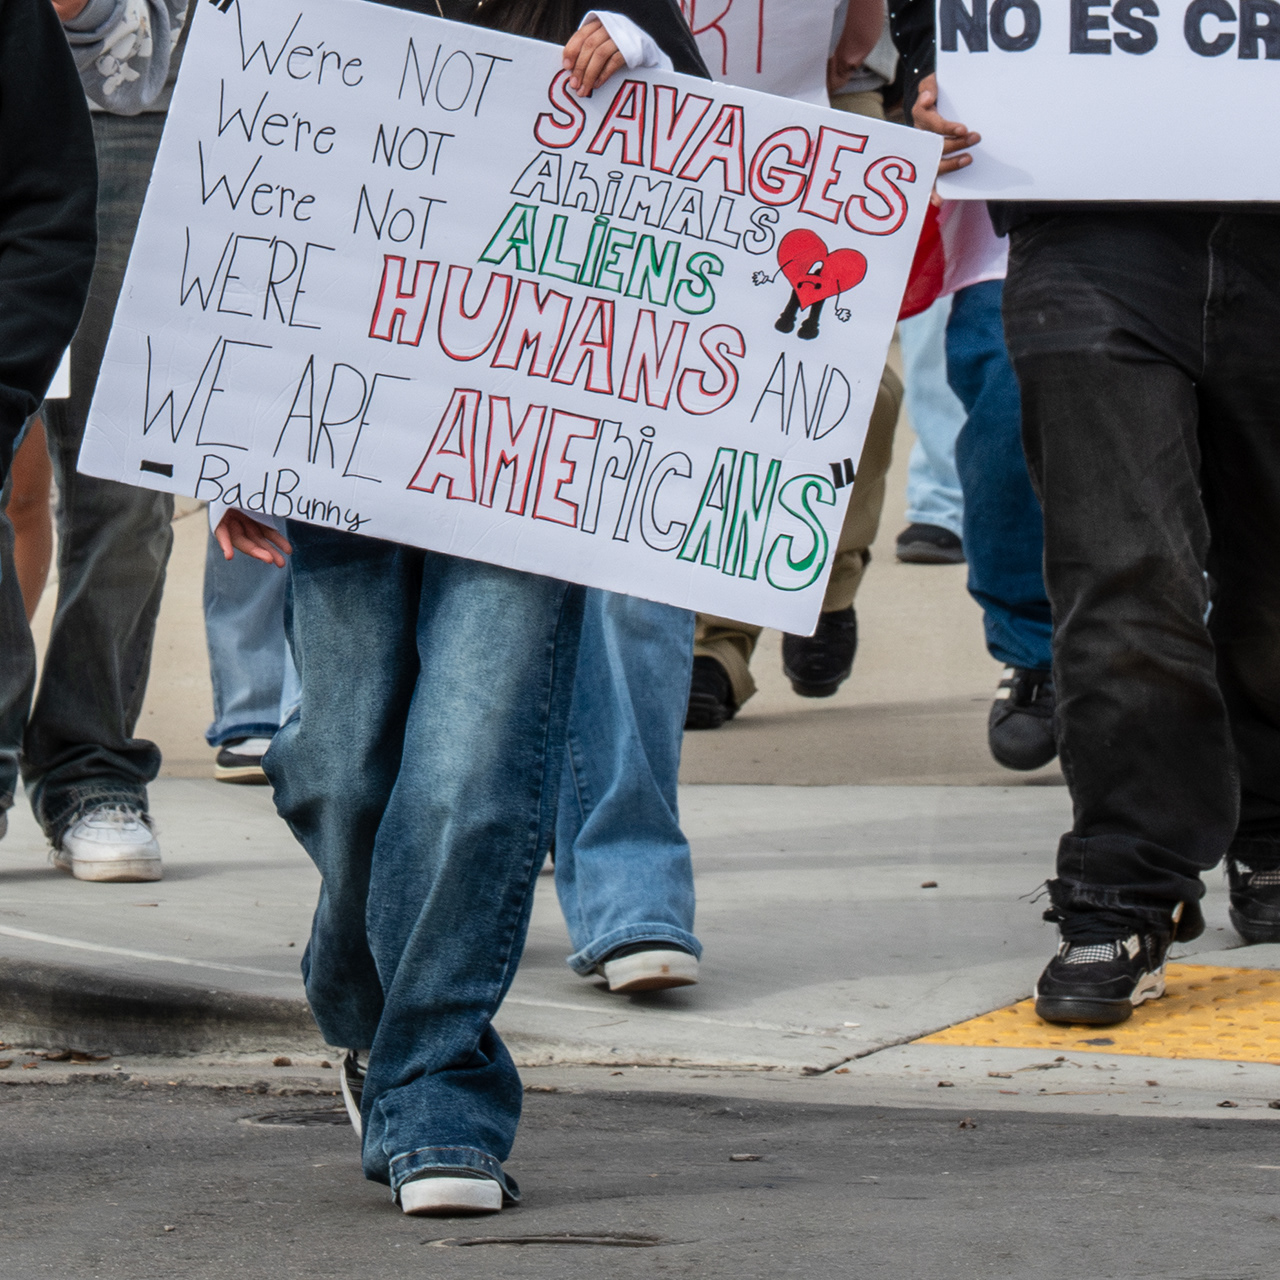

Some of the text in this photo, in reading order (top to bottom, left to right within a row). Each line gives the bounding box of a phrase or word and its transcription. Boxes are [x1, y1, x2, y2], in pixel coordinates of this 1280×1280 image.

[197, 139, 317, 222] We're
[217, 78, 337, 155] We're
[372, 123, 456, 176] NOT
[397, 36, 513, 118] NOT
[532, 68, 918, 236] SAVAGES
[143, 334, 274, 452] WE
[272, 353, 412, 484] ARE
[368, 253, 747, 417] HUMANS
[749, 350, 853, 442] AND
